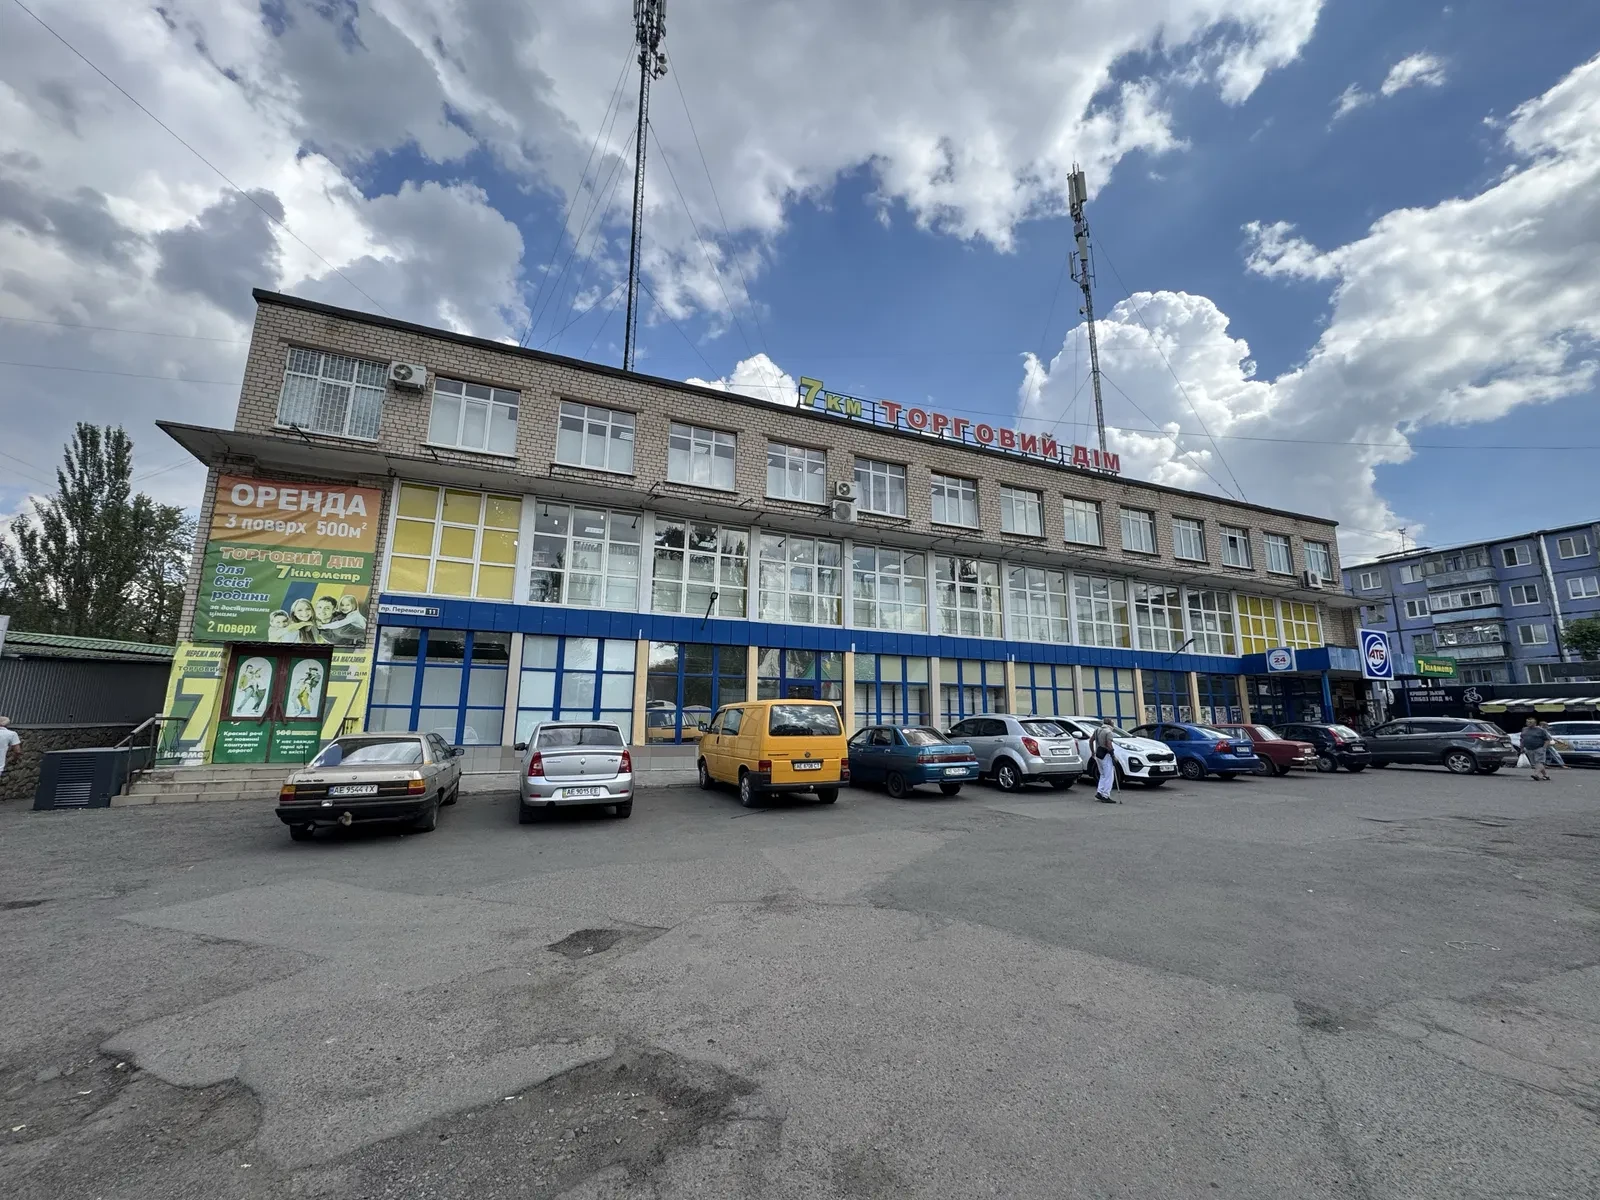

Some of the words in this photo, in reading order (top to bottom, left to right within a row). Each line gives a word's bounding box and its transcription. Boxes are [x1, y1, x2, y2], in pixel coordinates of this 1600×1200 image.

[801, 376, 823, 406] 7
[880, 400, 1058, 458] ТОРГОВИЙ
[1071, 444, 1120, 473] ДІМ
[231, 483, 367, 519] ОРЕНДА
[225, 514, 237, 529] 3
[241, 519, 307, 536] поверх
[220, 546, 322, 566] ТОРГОВИЙ
[327, 555, 364, 569] ДІМ
[215, 563, 245, 575] для
[276, 564, 292, 580] 7
[290, 568, 361, 583] кілометр
[213, 576, 252, 588] всієї
[210, 590, 270, 602] родини
[392, 606, 425, 614] Перемоги
[207, 621, 214, 632] 2
[216, 622, 257, 636] поверх
[1274, 656, 1286, 664] 24
[1369, 649, 1384, 660] АТБ
[1418, 660, 1424, 674] 7
[180, 677, 218, 740] 7
[320, 681, 360, 740] 7
[334, 786, 345, 794] AE
[346, 785, 364, 794] 9544
